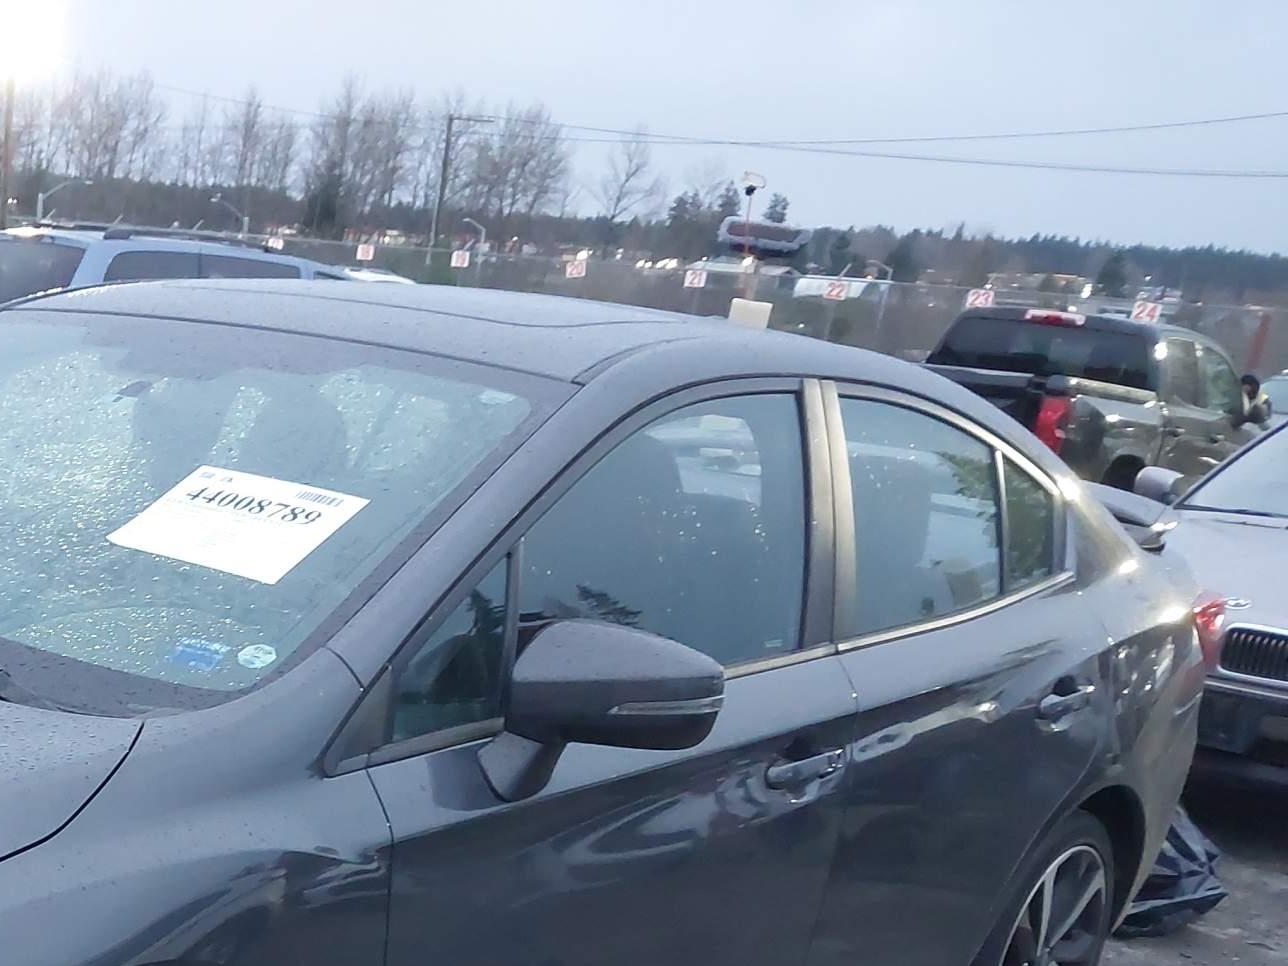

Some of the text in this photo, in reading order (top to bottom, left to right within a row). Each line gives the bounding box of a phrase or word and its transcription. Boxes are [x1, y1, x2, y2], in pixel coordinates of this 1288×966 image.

[567, 261, 584, 276] 20
[688, 271, 702, 287] 21
[825, 282, 843, 298] 22
[969, 290, 991, 306] 23
[1134, 302, 1158, 320] 24
[186, 486, 322, 525] 44008789
